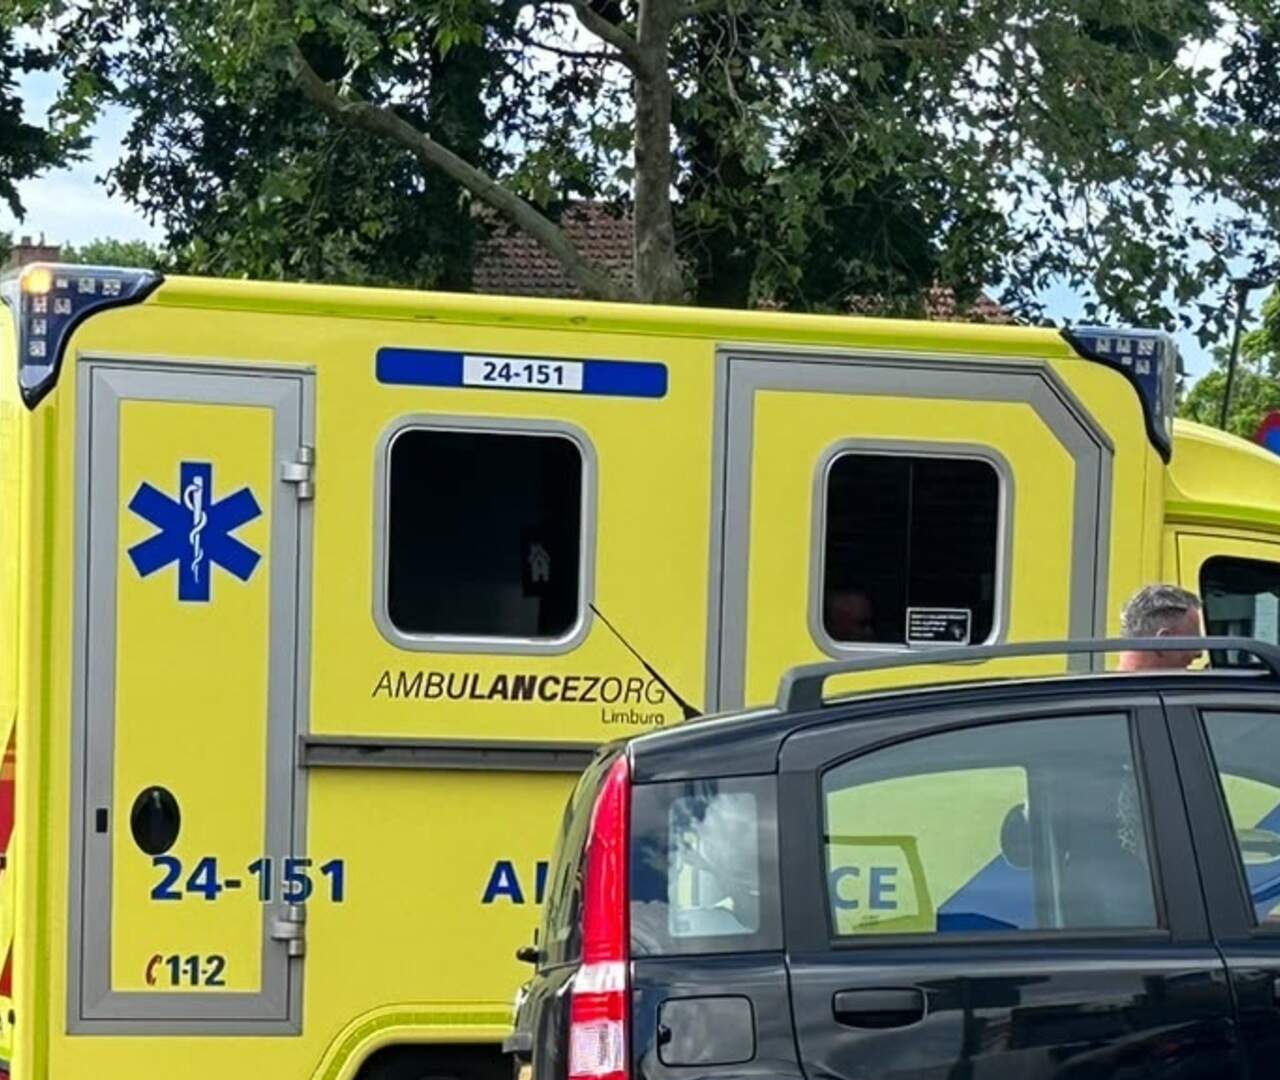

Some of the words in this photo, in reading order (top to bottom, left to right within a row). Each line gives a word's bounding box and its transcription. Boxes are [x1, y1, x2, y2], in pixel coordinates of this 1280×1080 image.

[483, 362, 565, 386] 24-151
[372, 670, 666, 704] AMBULANCEZORG
[150, 856, 346, 903] 24-151
